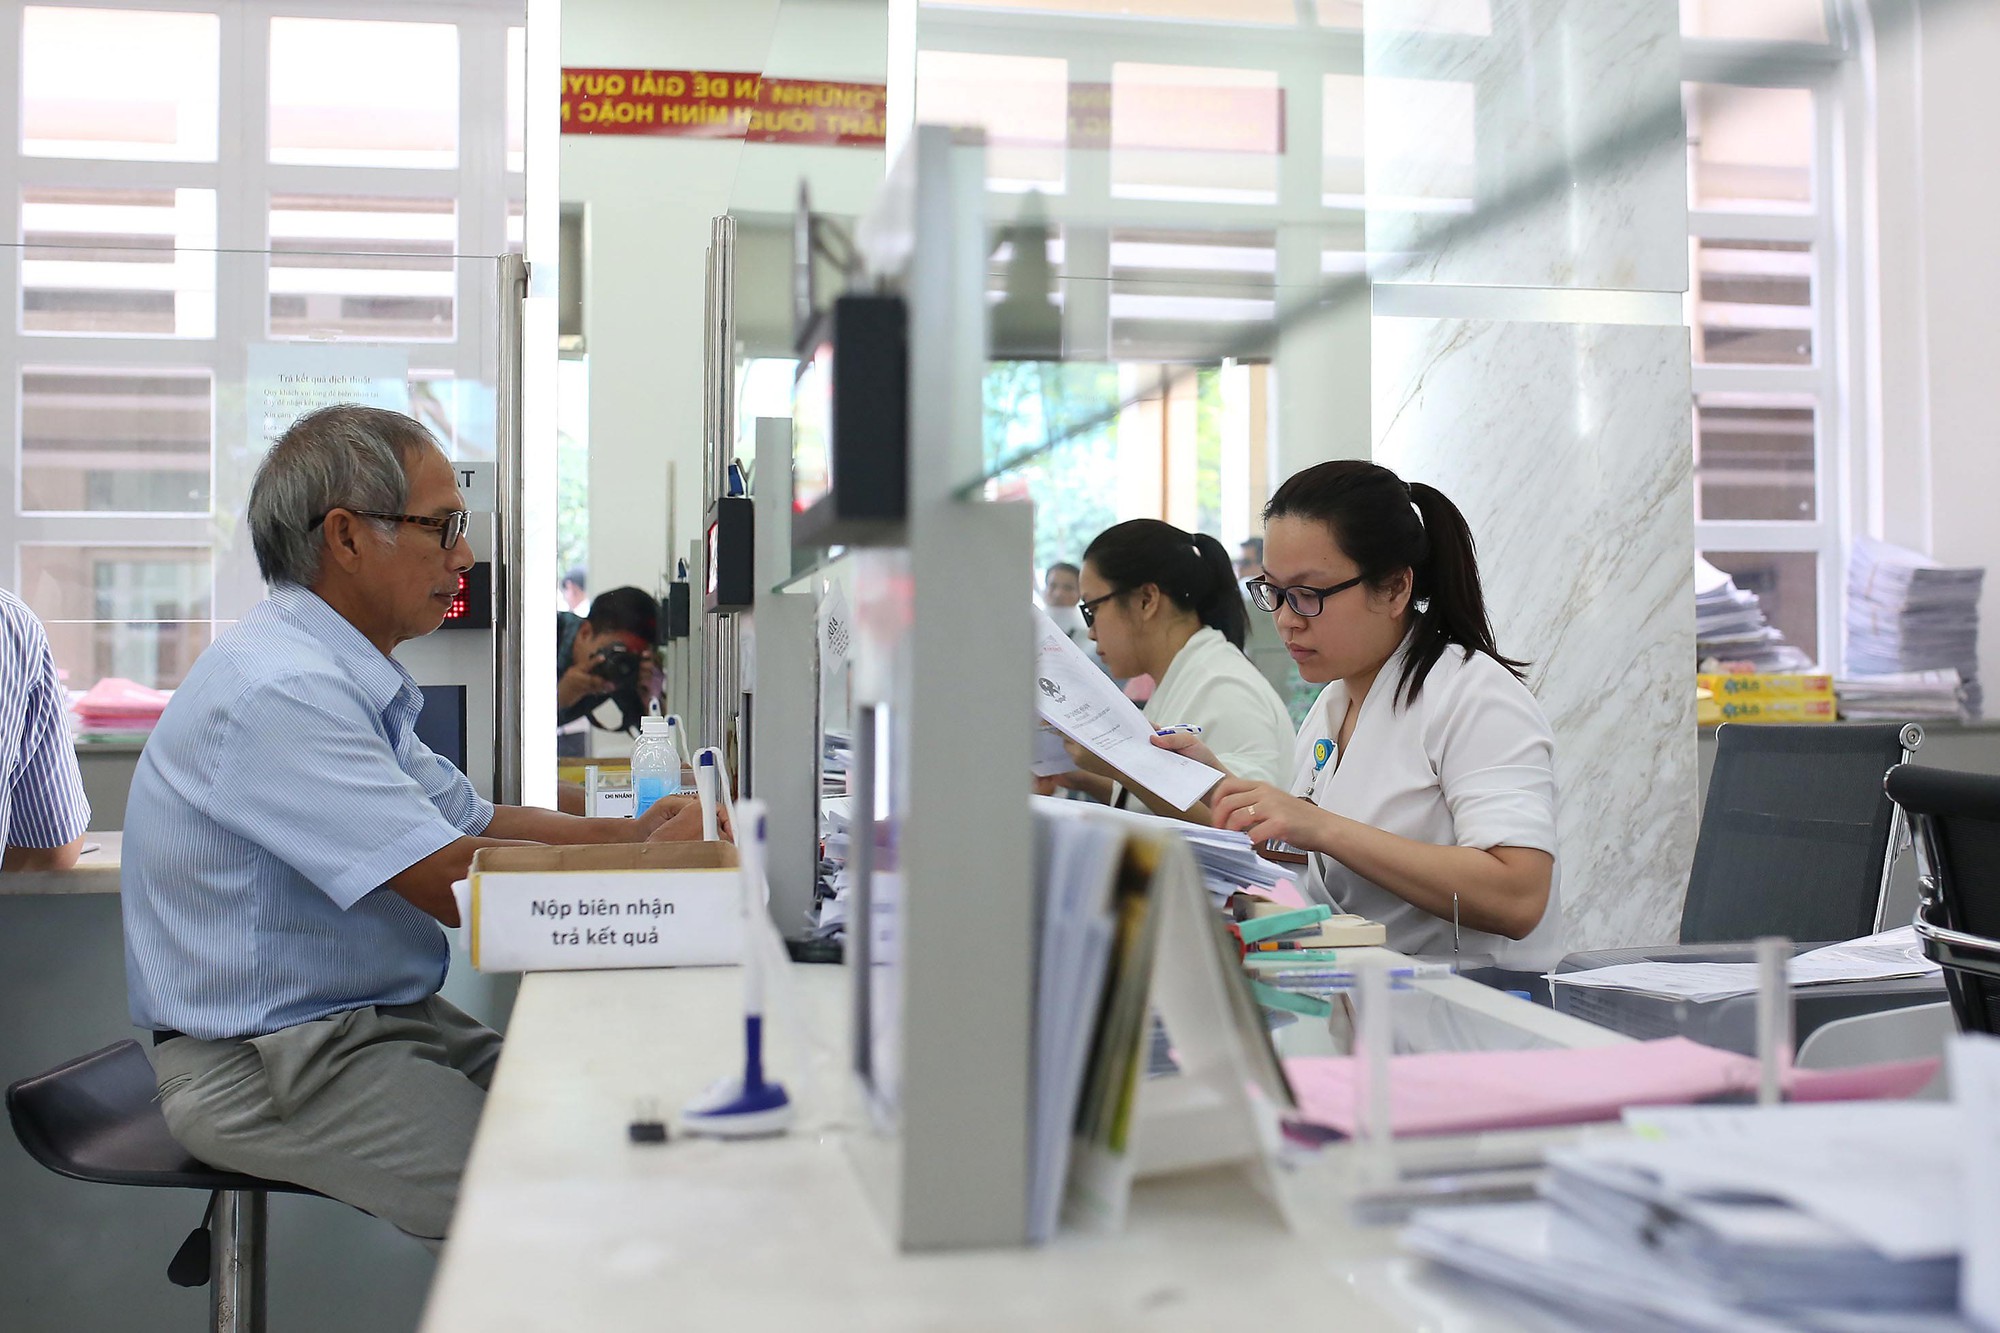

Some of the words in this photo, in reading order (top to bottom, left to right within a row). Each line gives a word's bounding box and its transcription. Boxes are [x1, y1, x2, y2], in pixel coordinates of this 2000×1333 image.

[531, 899, 572, 920] Nộp
[578, 898, 620, 916] biên
[626, 898, 675, 919] nhận
[552, 926, 580, 945] trả
[586, 925, 617, 945] kết
[623, 926, 659, 947] quả
